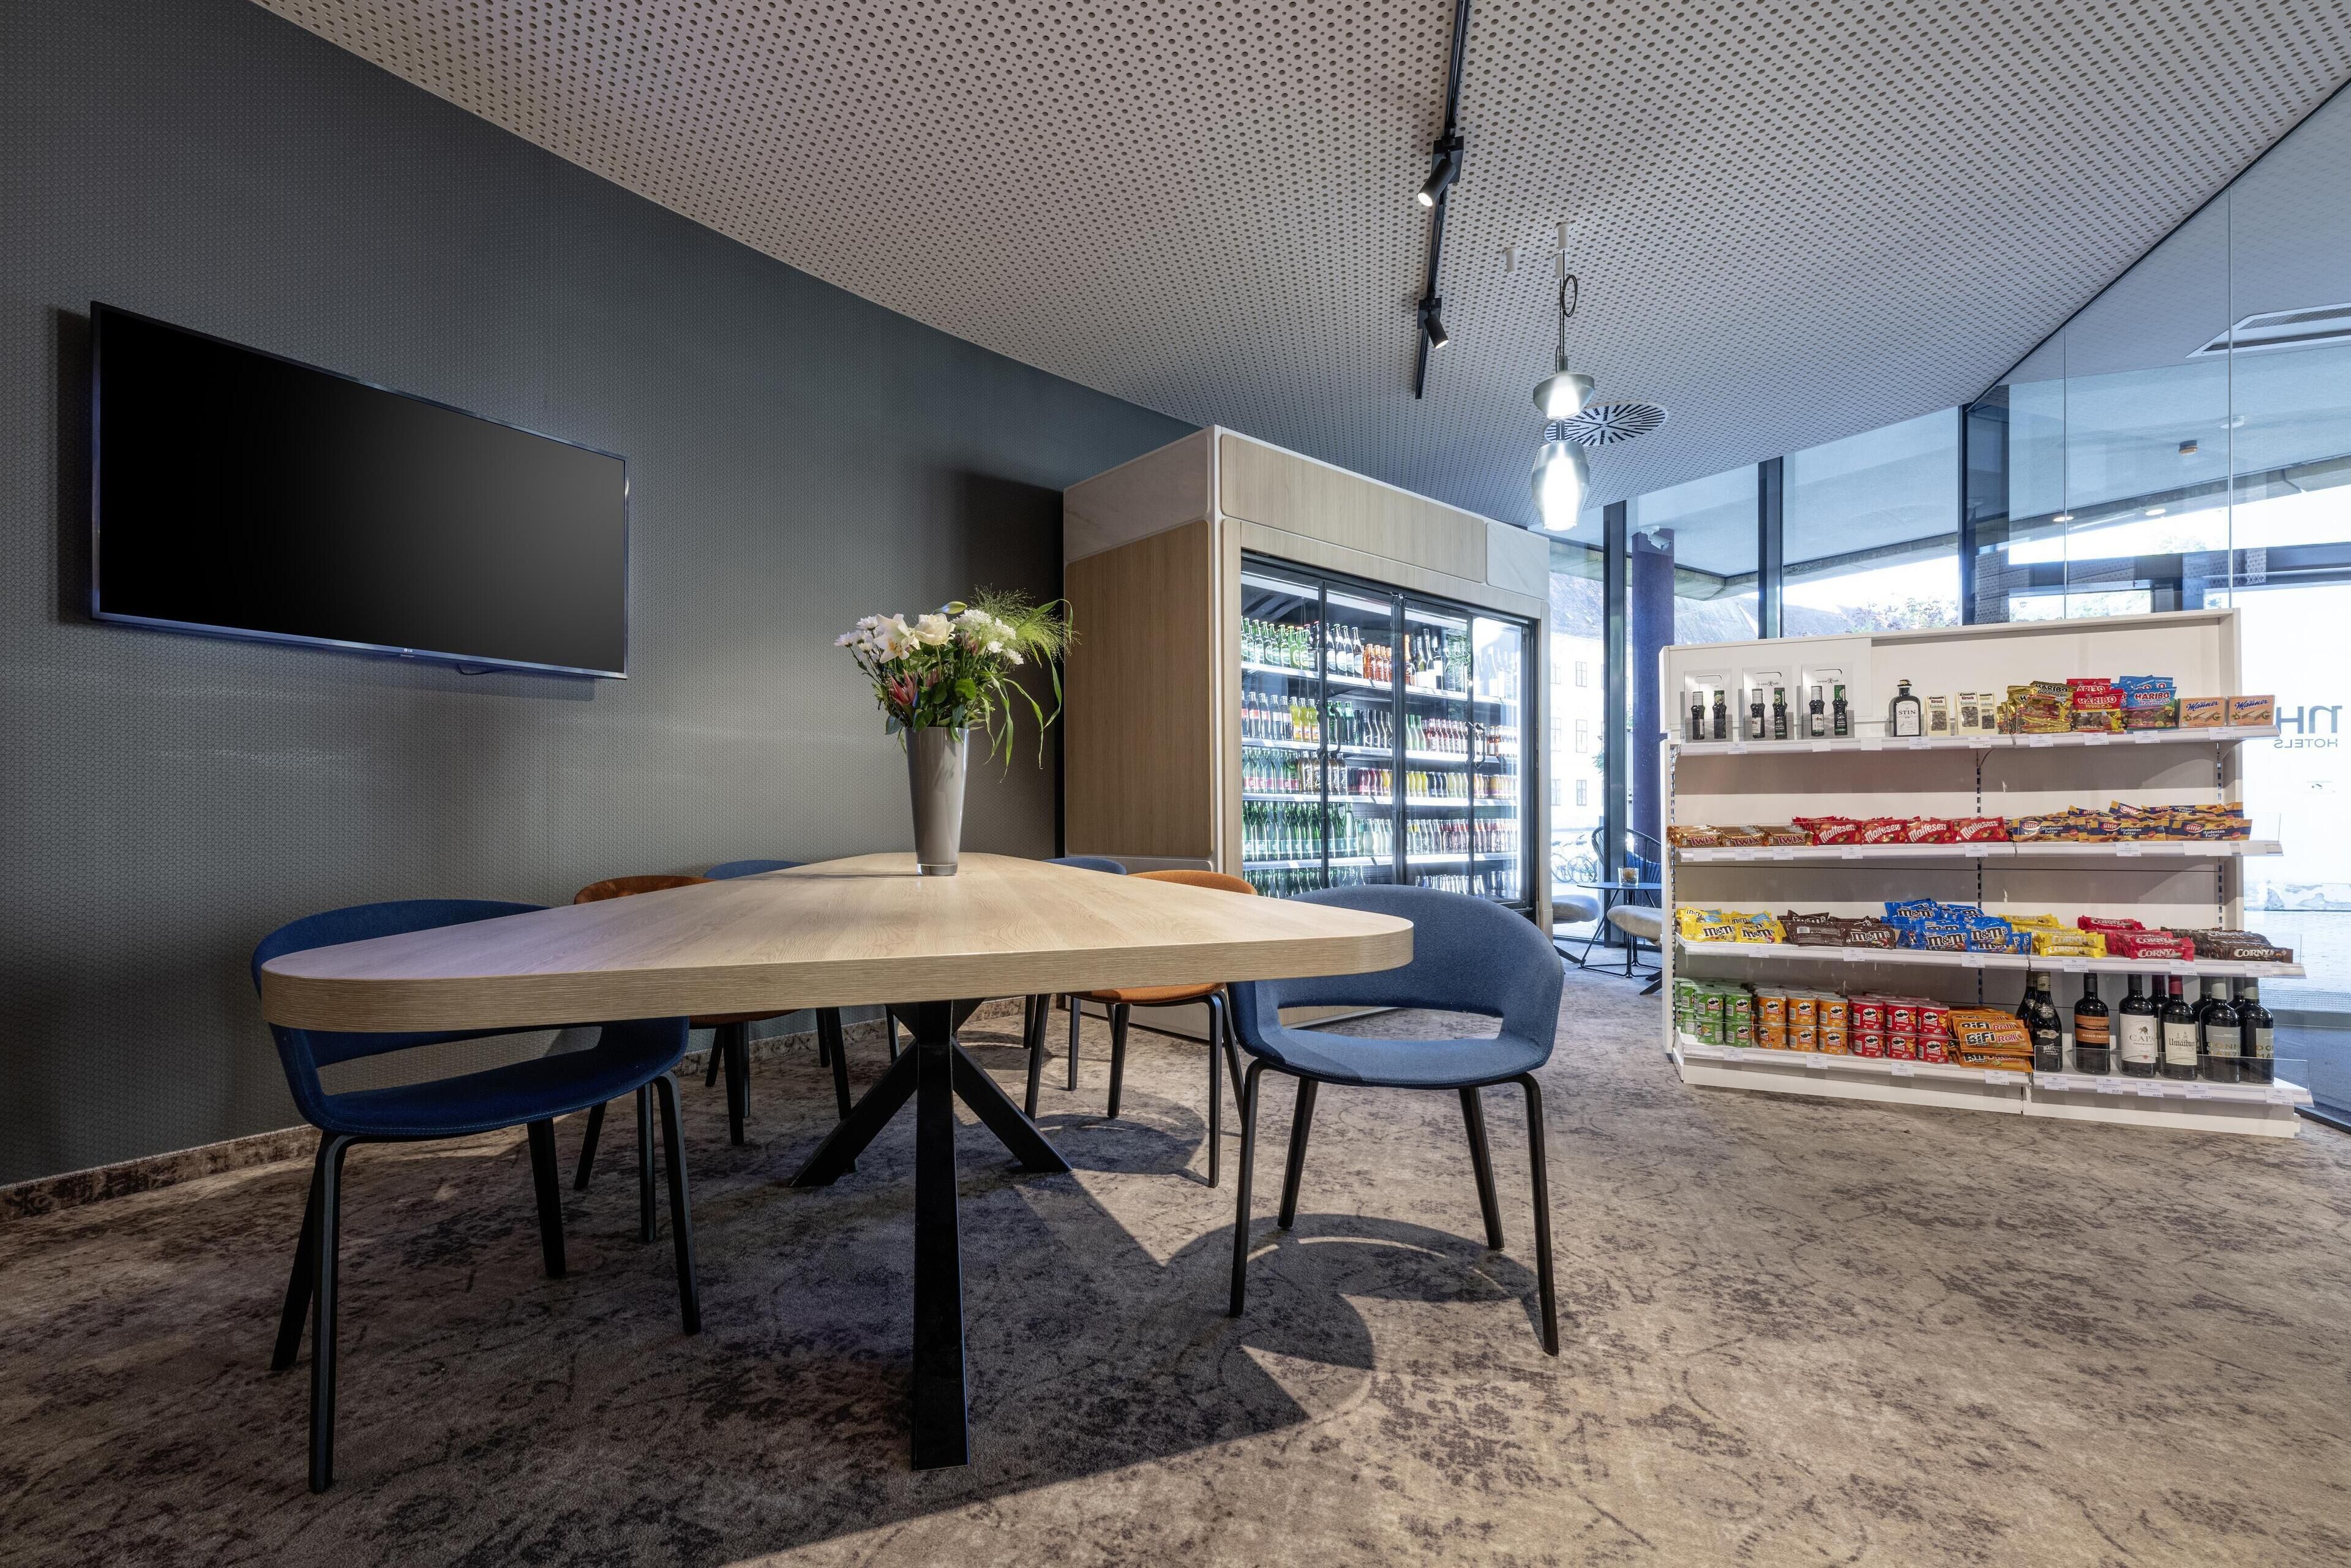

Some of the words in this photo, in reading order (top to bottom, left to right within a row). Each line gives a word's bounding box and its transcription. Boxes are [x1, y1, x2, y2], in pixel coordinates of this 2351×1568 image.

[2036, 684, 2068, 692] HARIBO
[2077, 695, 2117, 705] HARIBO
[2134, 691, 2170, 700] HARIBO
[1819, 824, 1856, 843] Maltesers
[1864, 823, 1901, 843] Maltesers
[1908, 823, 1947, 842] Maltesers
[1960, 820, 1998, 840] Maltesers
[1703, 925, 1735, 937] m&m's
[1742, 928, 1775, 937] m&m's
[1851, 931, 1891, 942] m&m's
[1927, 932, 1968, 946] m&m's
[2137, 949, 2172, 958] CORNY
[2234, 948, 2271, 958] CORNY
[1998, 1033, 2017, 1042] Roll
